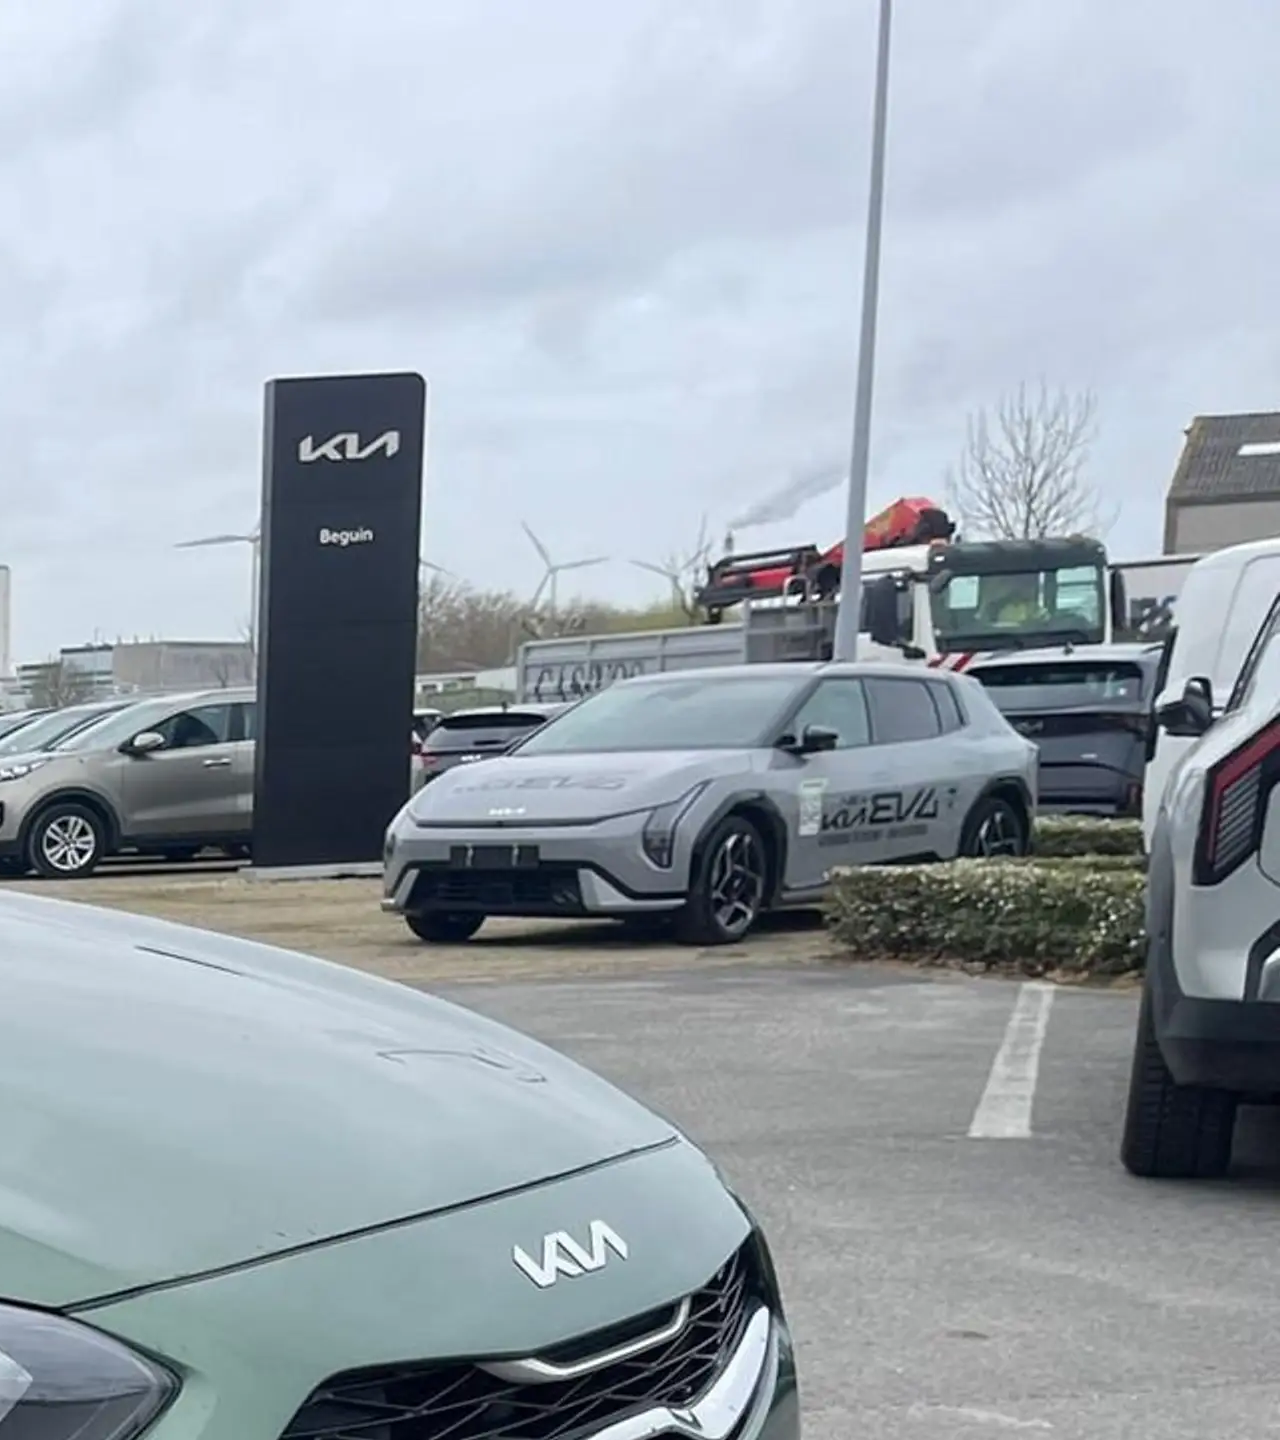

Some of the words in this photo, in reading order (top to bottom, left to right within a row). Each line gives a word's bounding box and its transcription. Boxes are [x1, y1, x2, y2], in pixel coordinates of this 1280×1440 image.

[299, 431, 399, 461] KIA
[320, 527, 373, 546] Beguin
[513, 1219, 628, 1288] KIA
